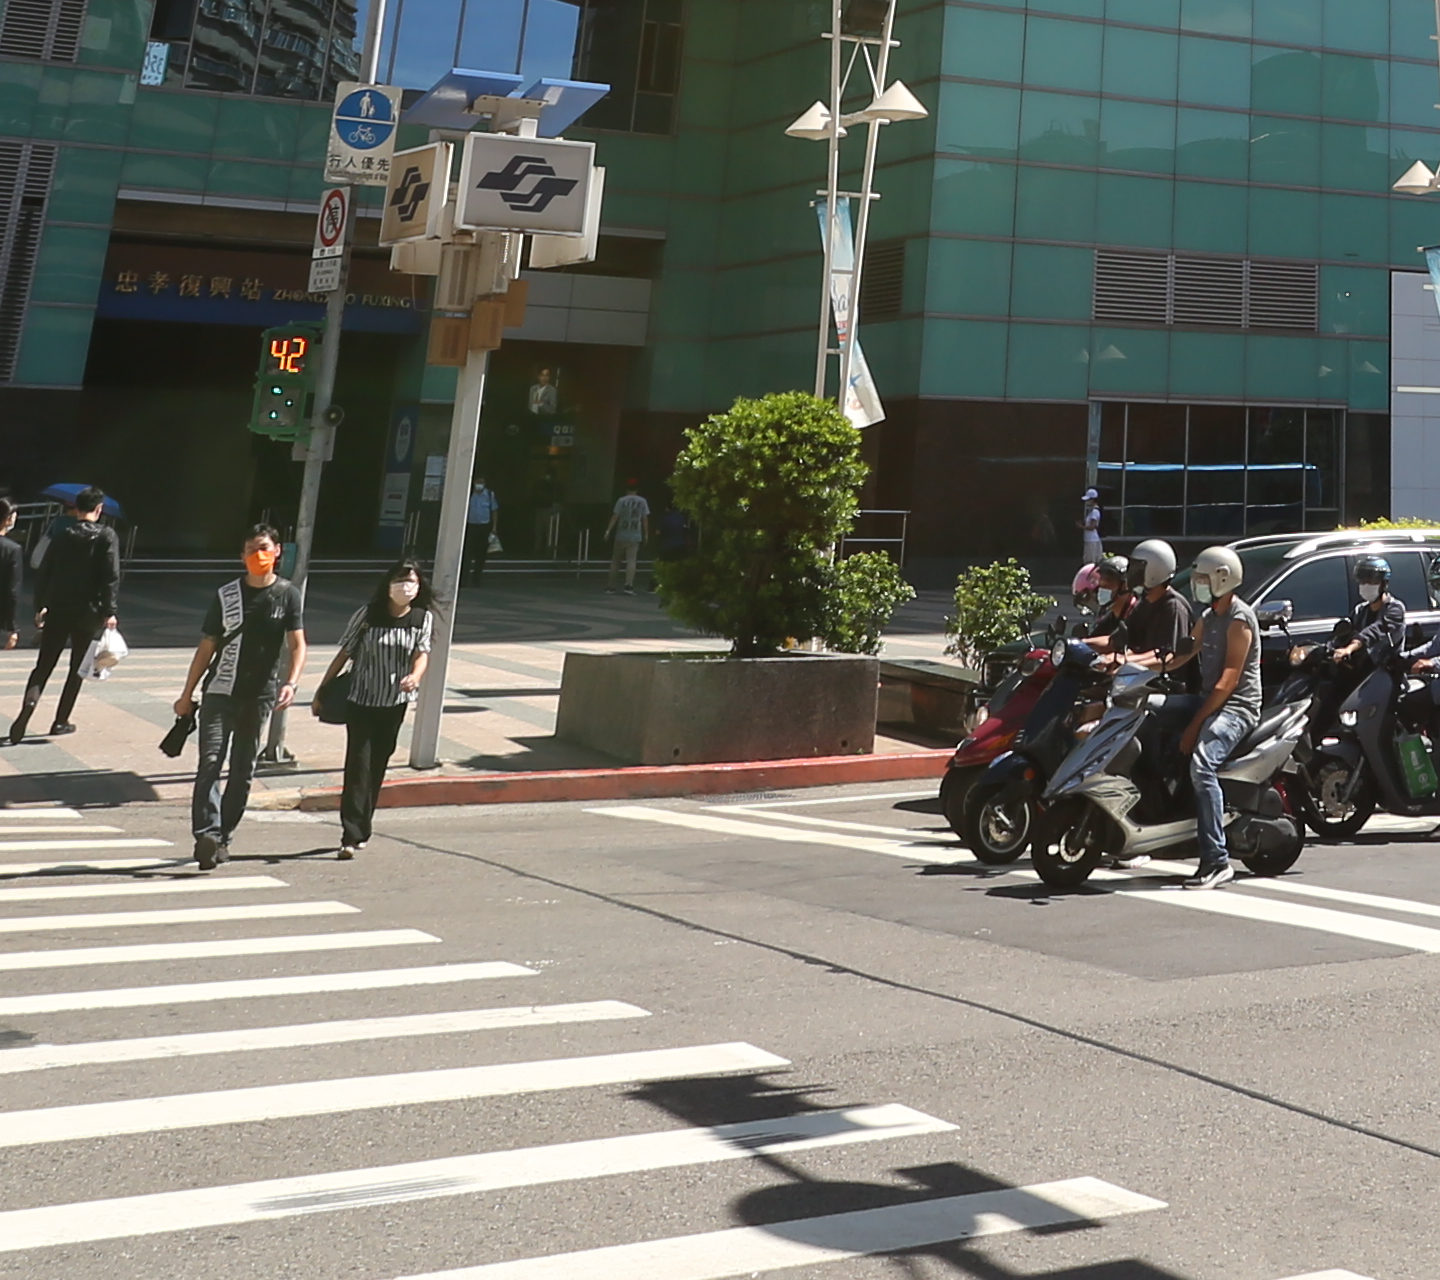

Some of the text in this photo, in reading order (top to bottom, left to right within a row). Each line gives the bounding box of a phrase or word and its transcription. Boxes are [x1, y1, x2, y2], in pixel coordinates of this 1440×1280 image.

[328, 153, 390, 172] 行人優先
[114, 269, 265, 301] 忠孝復興站
[361, 292, 412, 309] FUXING
[269, 336, 309, 373] 42
